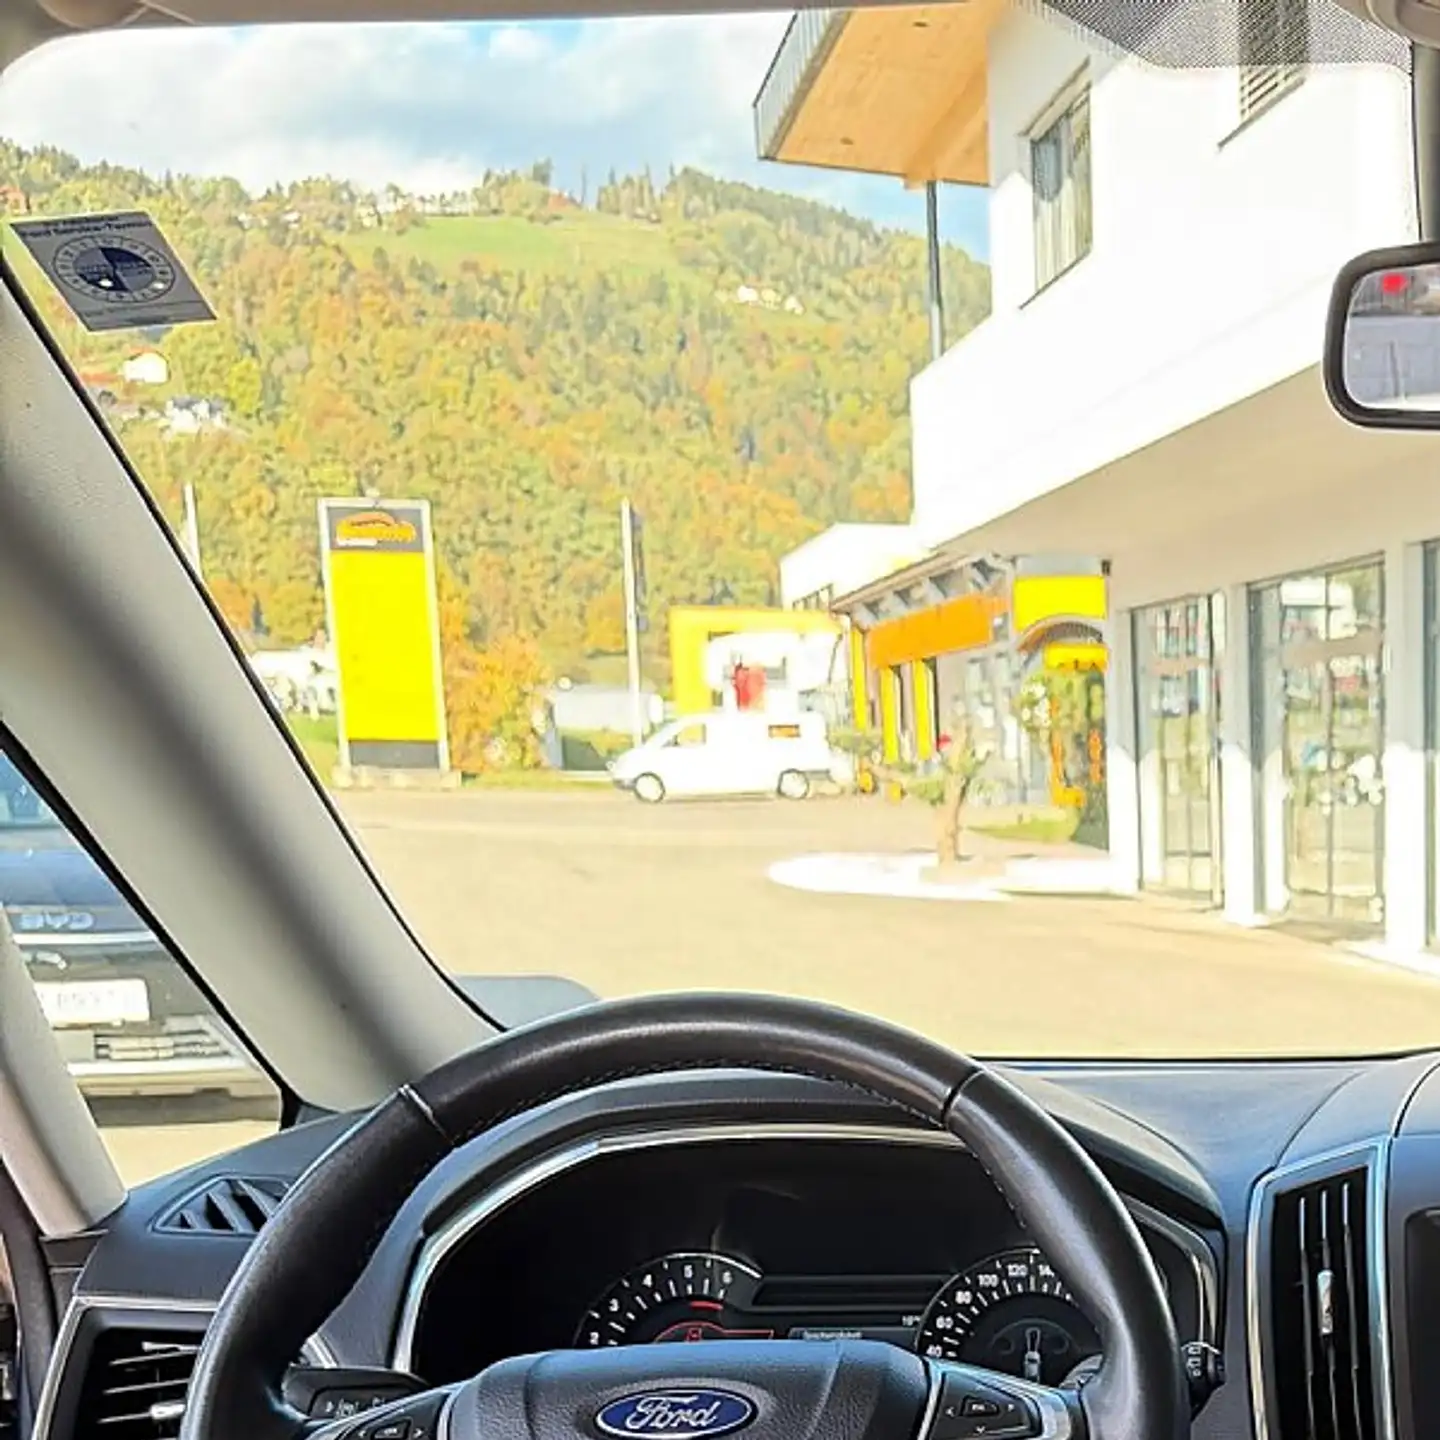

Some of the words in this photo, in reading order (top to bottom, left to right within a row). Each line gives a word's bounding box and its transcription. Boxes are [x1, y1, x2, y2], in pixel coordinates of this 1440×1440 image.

[684, 1264, 692, 1278] 5
[722, 1270, 732, 1283] 6
[1007, 1263, 1028, 1278] 120
[1039, 1264, 1055, 1277] 14
[642, 1274, 653, 1287] 4
[978, 1274, 998, 1288] 100
[955, 1291, 971, 1305] 80
[609, 1299, 619, 1312] 3
[935, 1316, 953, 1329] 60
[589, 1332, 599, 1345] 2
[625, 1395, 721, 1429] Ford
